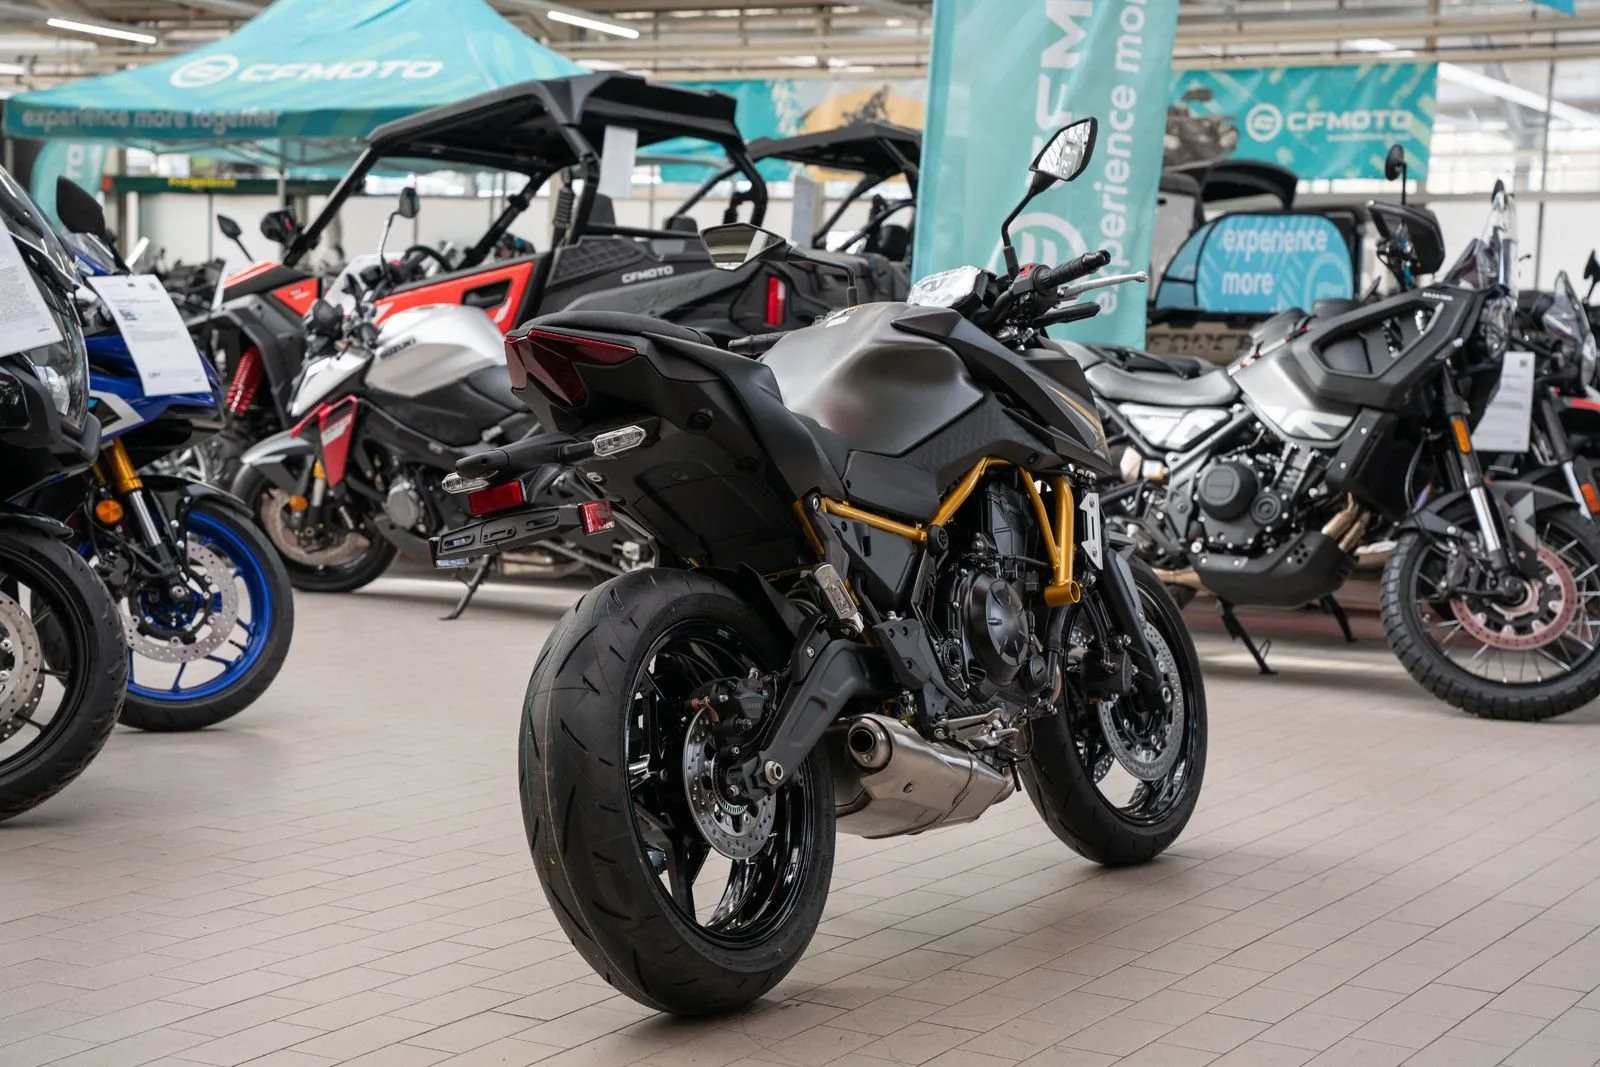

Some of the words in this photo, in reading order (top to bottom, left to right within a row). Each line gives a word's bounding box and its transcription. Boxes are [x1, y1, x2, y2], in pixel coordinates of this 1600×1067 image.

[1115, 0, 1150, 73] mo
[237, 60, 444, 82] CFMOTO
[1025, 0, 1092, 189] FM
[134, 109, 187, 128] more
[1286, 109, 1413, 132] CFMOTO
[1222, 221, 1328, 262] experience
[621, 265, 674, 284] CFMOTO
[1222, 271, 1274, 295] more
